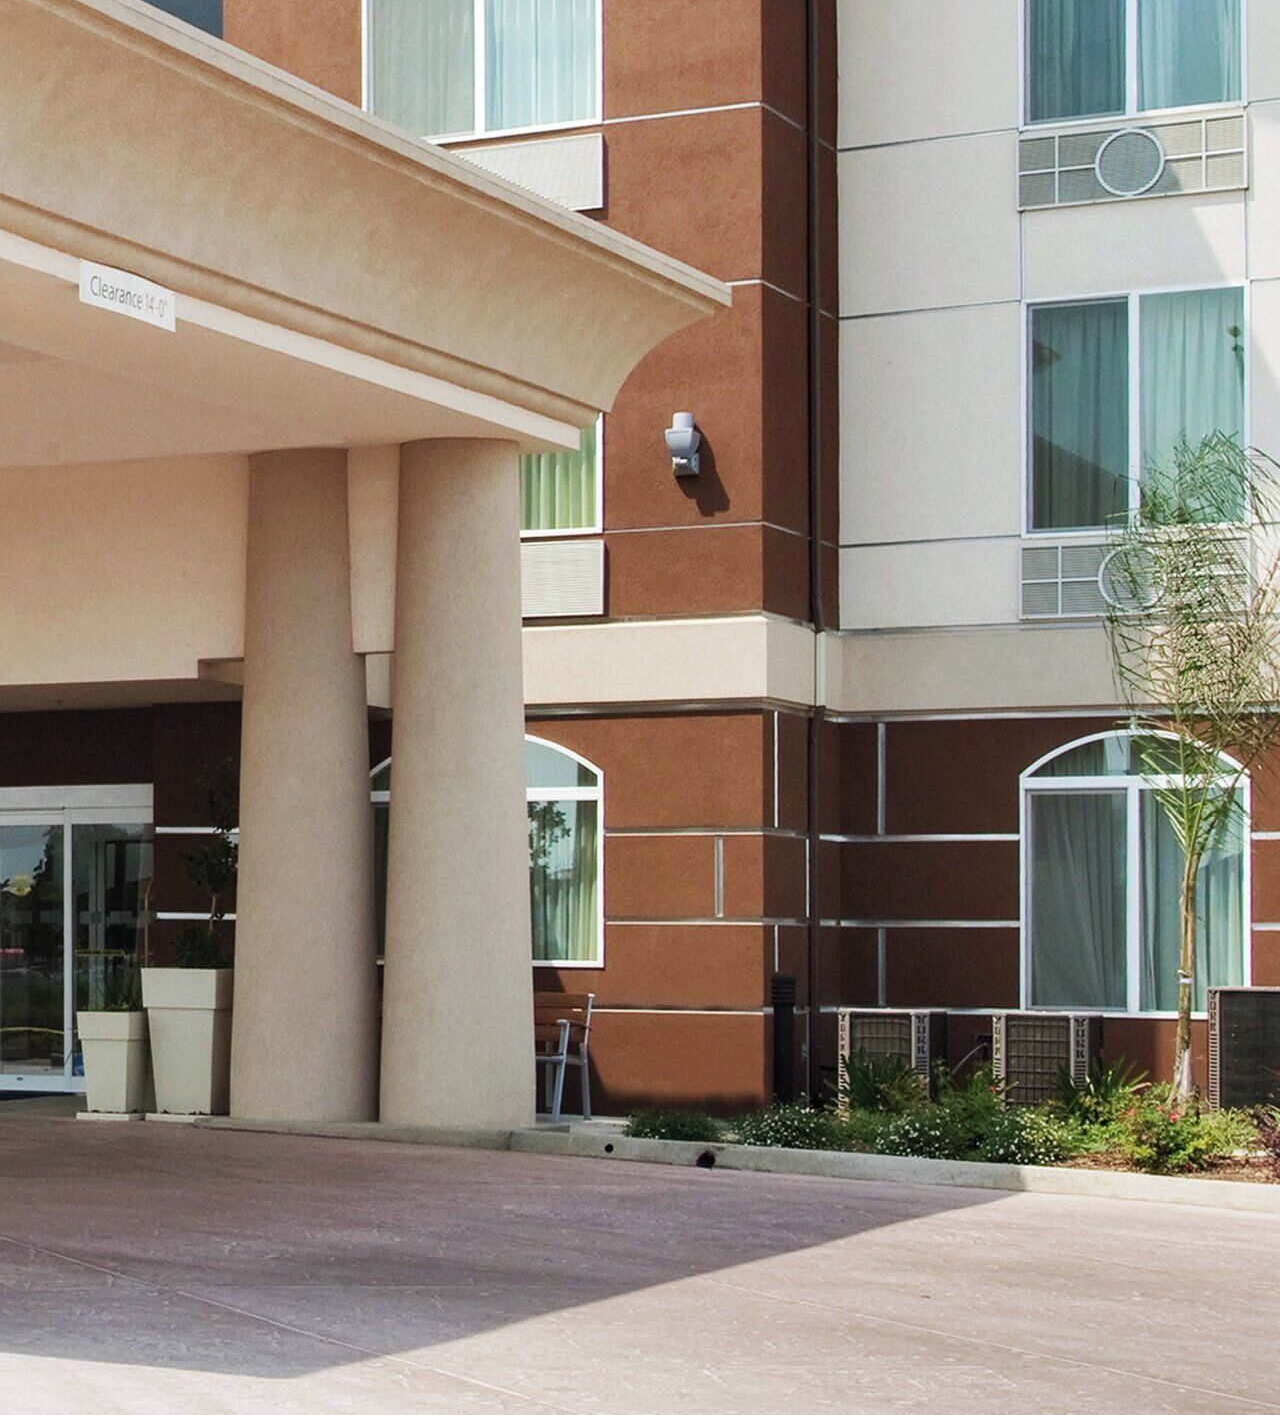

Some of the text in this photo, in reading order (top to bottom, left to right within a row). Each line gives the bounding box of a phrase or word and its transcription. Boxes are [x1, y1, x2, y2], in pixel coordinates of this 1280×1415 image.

[90, 275, 143, 310] Clearance
[915, 1015, 928, 1055] YORK
[1074, 1018, 1087, 1058] YORK
